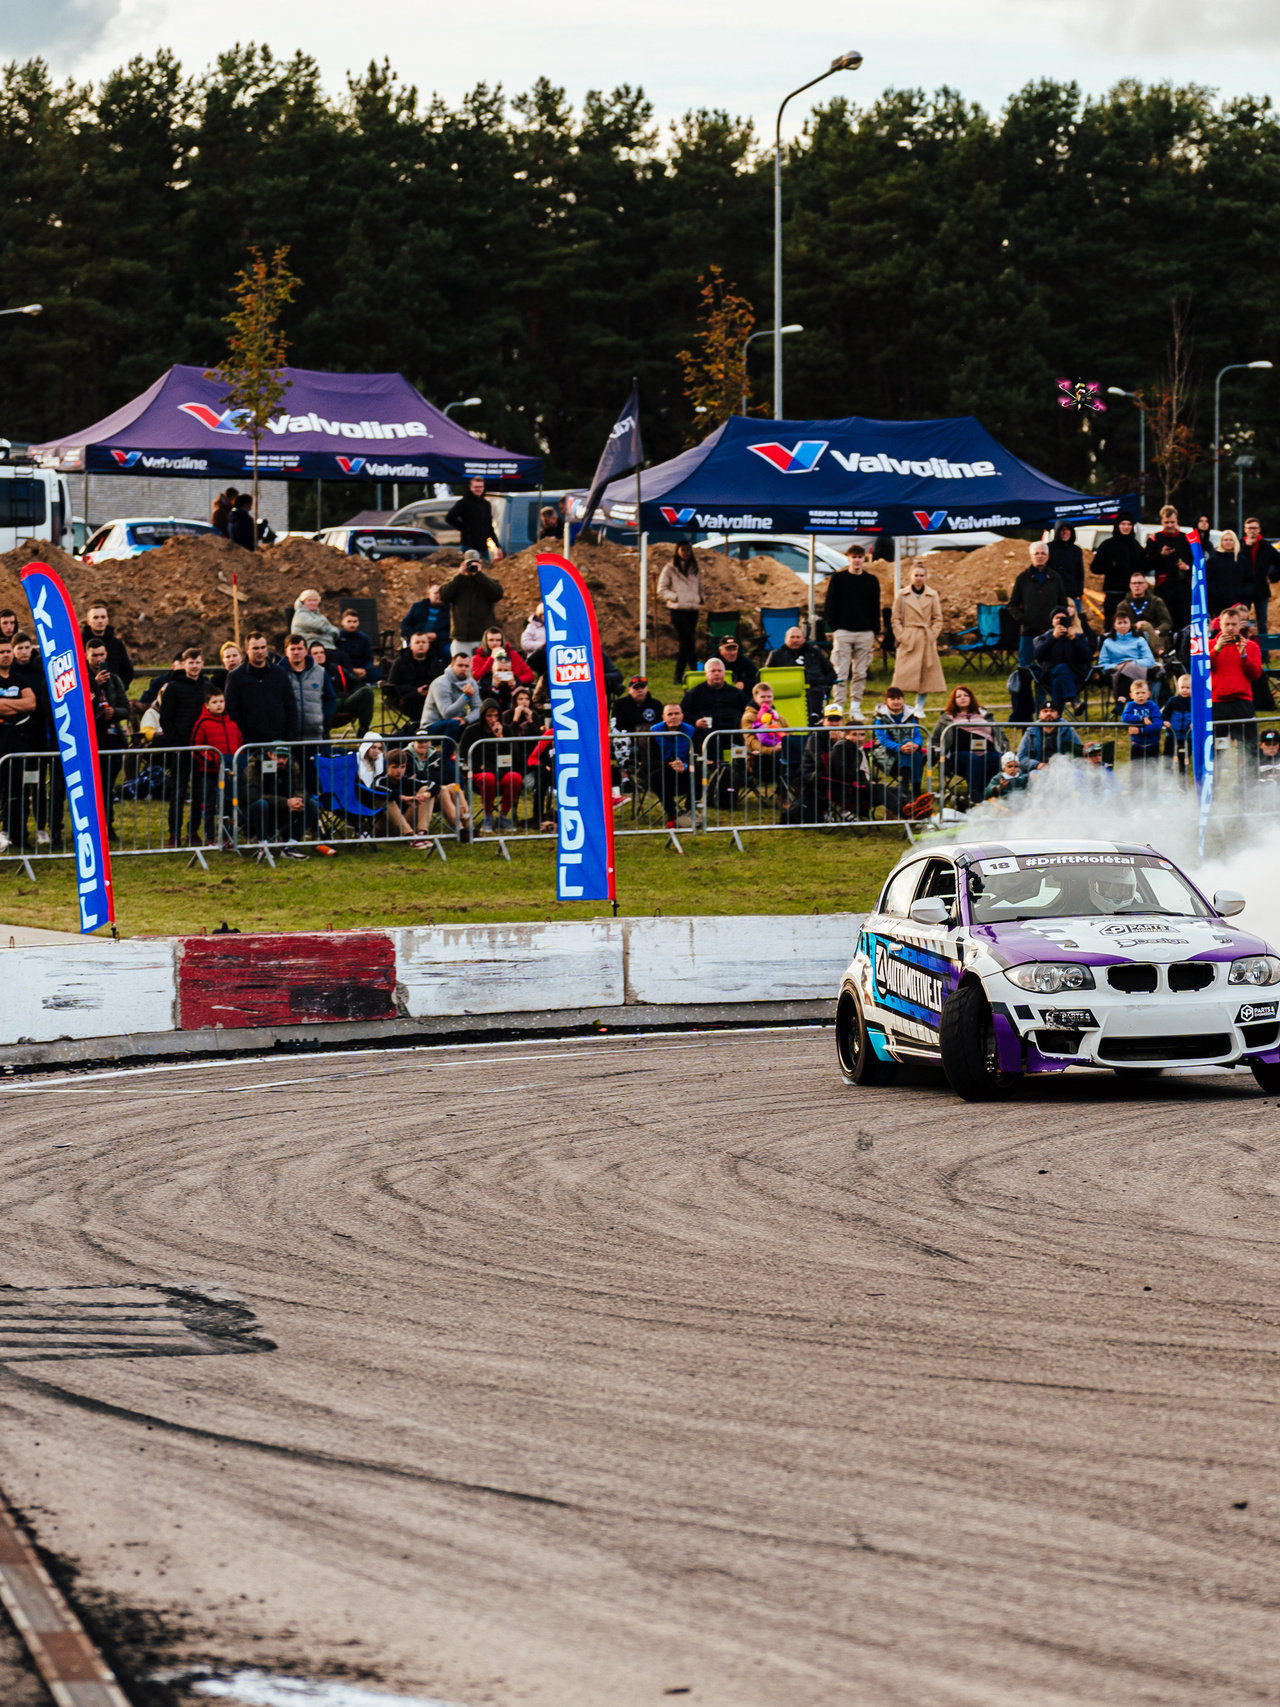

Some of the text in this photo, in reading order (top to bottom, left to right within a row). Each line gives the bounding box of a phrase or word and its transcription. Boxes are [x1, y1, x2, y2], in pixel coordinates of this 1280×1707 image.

[266, 412, 428, 439] Valvoline
[141, 456, 208, 470] Valvoline
[365, 463, 429, 477] Valvoline
[829, 450, 997, 479] Valvoline
[696, 513, 773, 529] Valvoline
[988, 862, 1011, 870] 18
